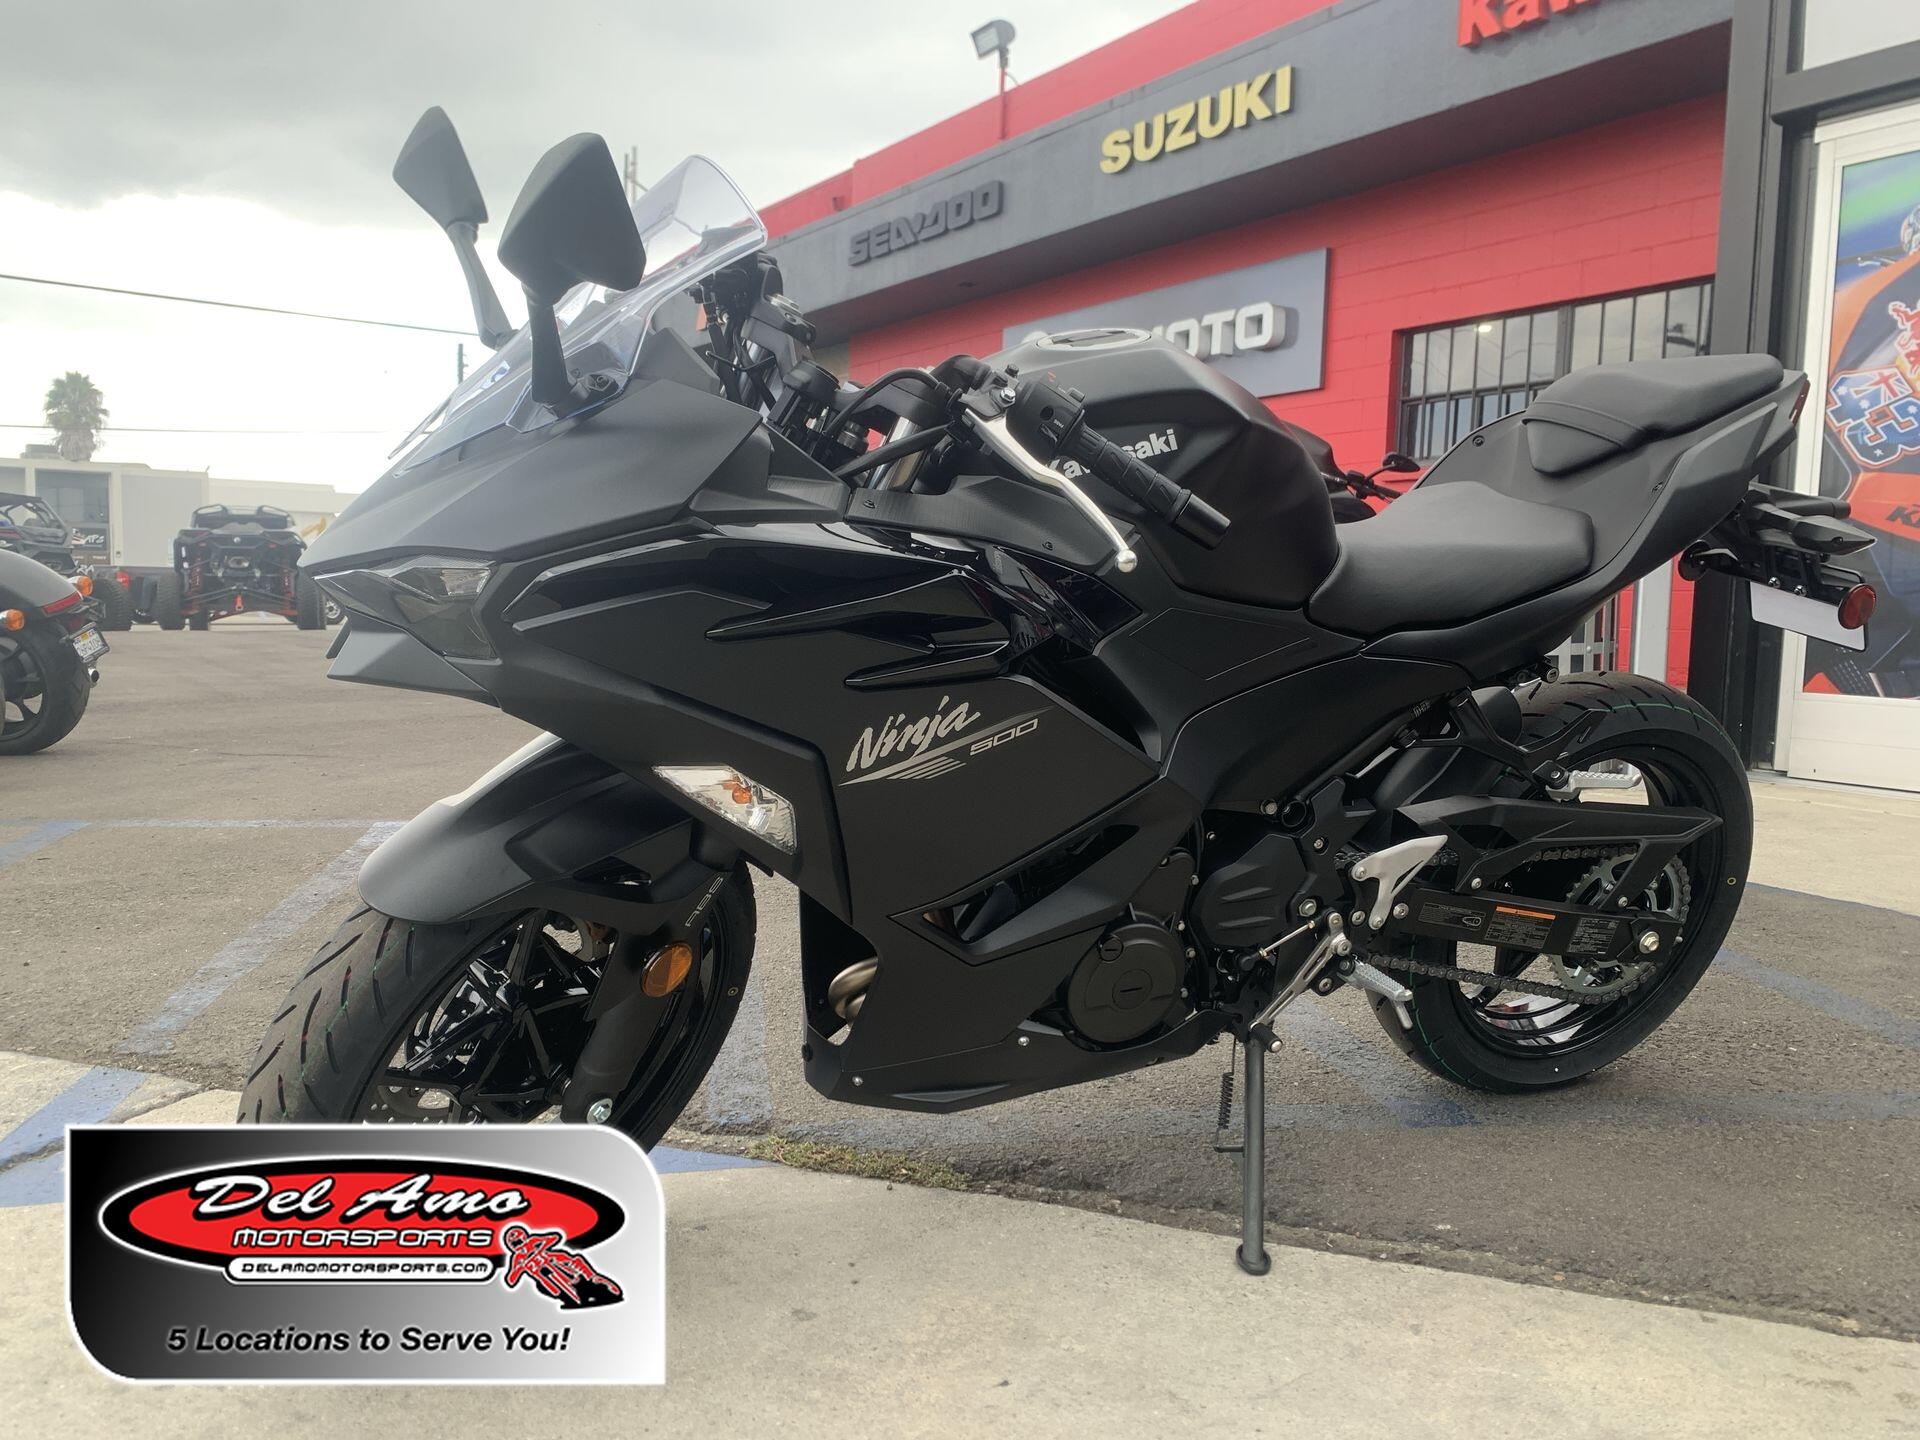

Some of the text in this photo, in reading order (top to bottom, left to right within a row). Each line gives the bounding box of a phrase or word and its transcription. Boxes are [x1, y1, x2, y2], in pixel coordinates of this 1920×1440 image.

[1100, 64, 1294, 174] SUZUKI
[846, 695, 981, 772] Ninja
[970, 718, 1039, 756] 500
[685, 877, 724, 927] ABS
